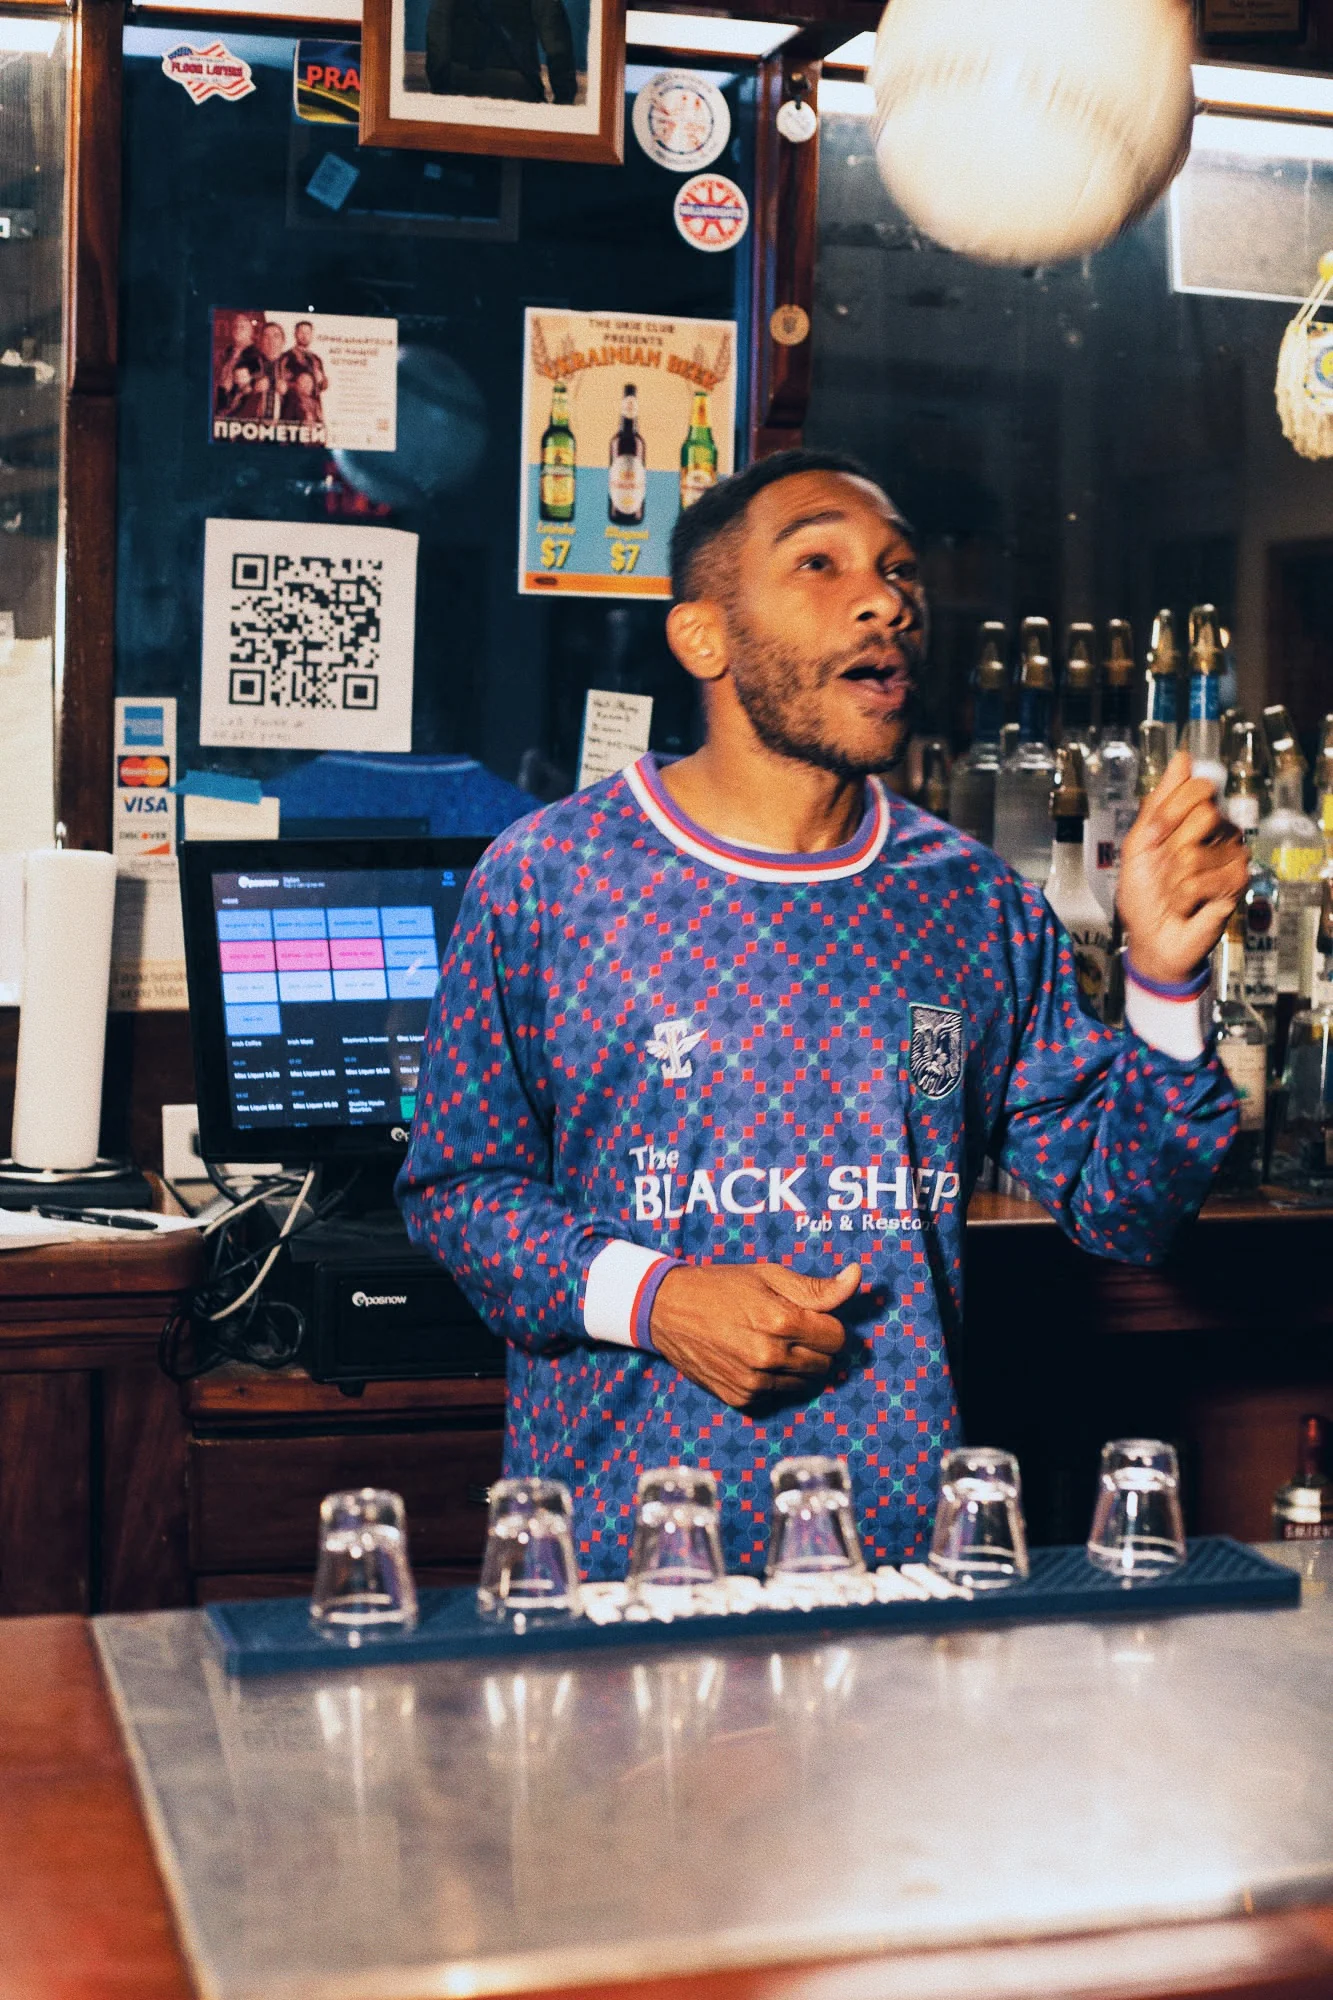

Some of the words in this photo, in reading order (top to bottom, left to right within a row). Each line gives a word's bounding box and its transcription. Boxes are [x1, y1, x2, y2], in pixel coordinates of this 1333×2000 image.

[603, 333, 663, 346] PRESENTS
[213, 420, 326, 444] ПРОМЕТЕЙ
[541, 536, 571, 569] $7
[610, 541, 640, 573] $7
[124, 796, 168, 813] VISA
[629, 1144, 680, 1171] The
[634, 1167, 807, 1221] BLACK
[827, 1166, 961, 1212] SHEP
[796, 1215, 833, 1232] Pub
[839, 1215, 854, 1231] &
